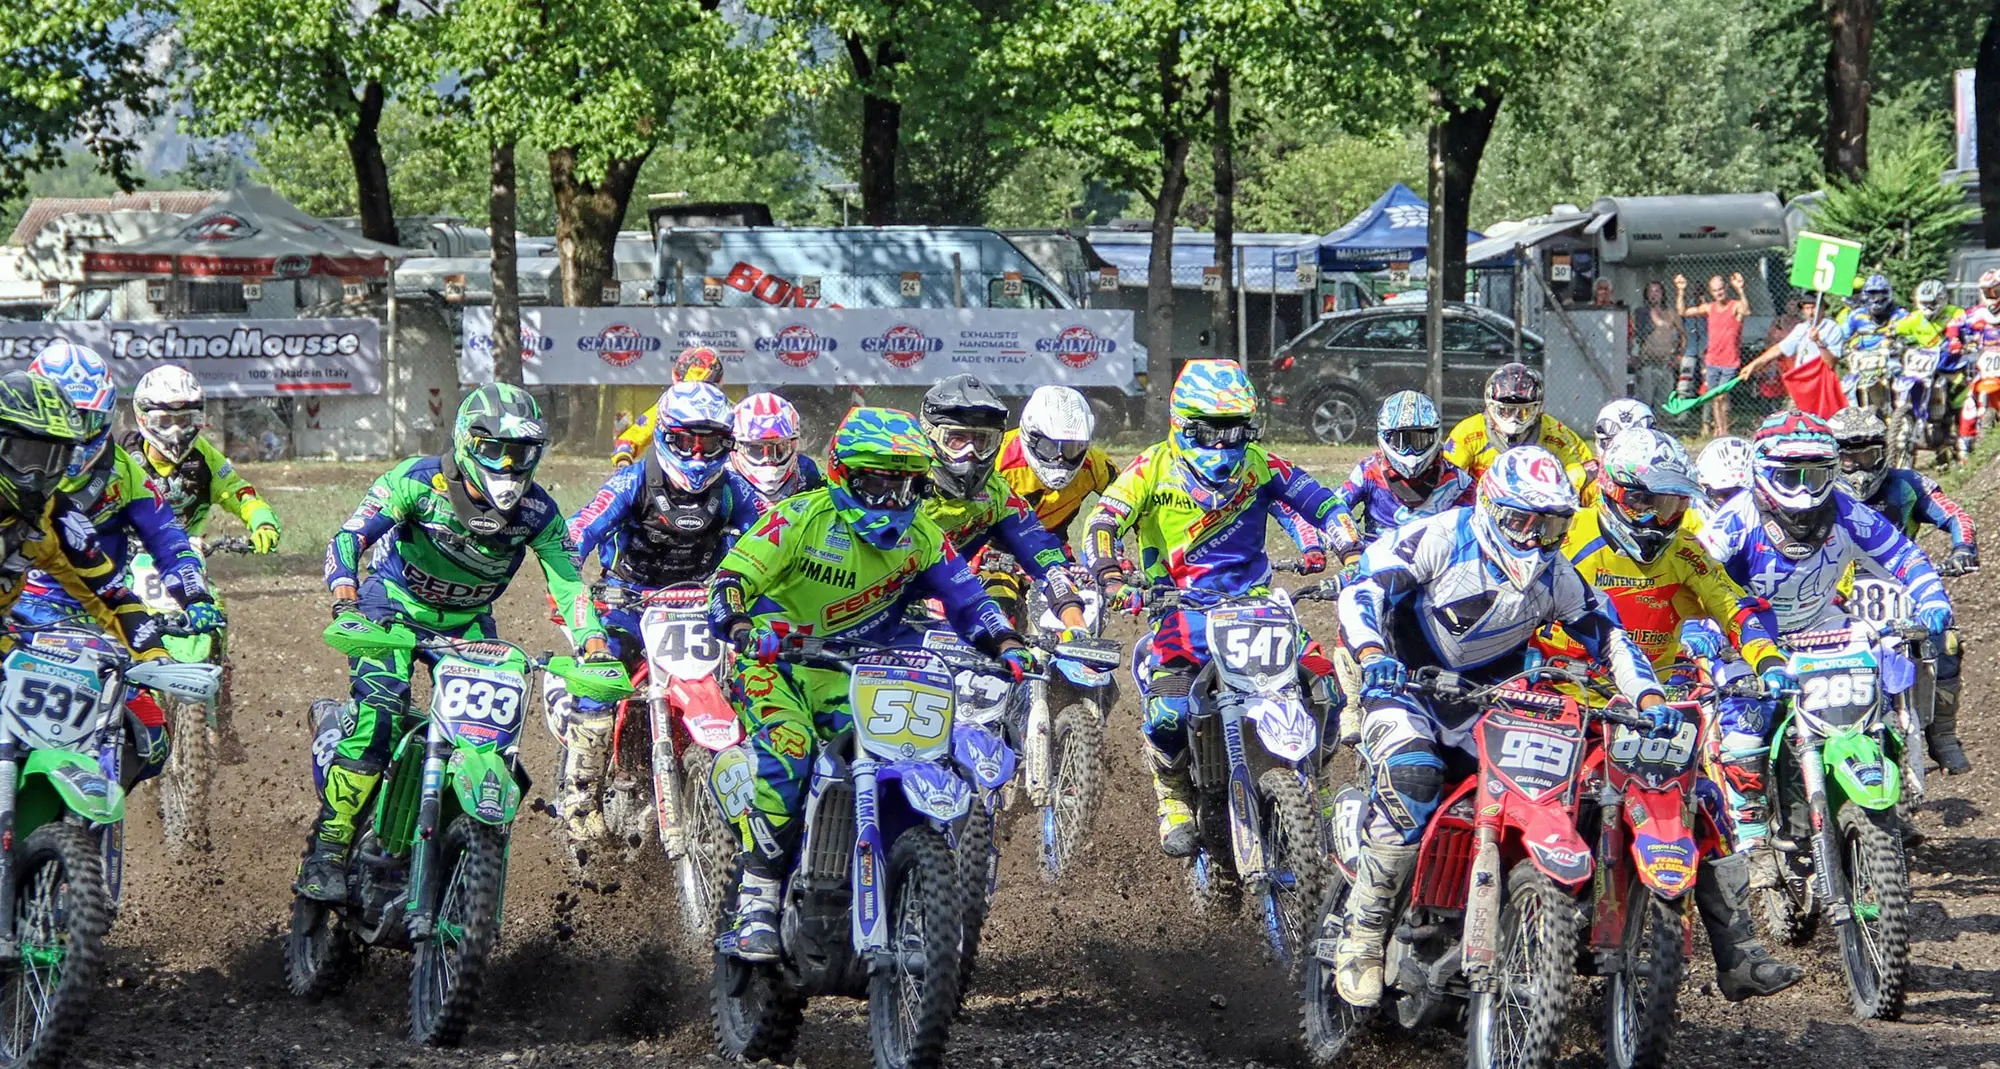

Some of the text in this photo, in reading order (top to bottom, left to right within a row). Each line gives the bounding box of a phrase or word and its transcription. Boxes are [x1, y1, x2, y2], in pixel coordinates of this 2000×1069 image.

[1555, 267, 1567, 277] 30
[1812, 242, 1840, 293] 5
[1102, 277, 1114, 288] 26
[1204, 275, 1217, 287] 27
[1300, 273, 1312, 283] 28
[1393, 273, 1405, 281] 29
[245, 286, 258, 297] 18
[803, 285, 817, 297] 23
[903, 281, 916, 293] 24
[1005, 281, 1018, 292] 25
[602, 289, 617, 301] 21
[705, 287, 719, 299] 22
[678, 330, 738, 339] EXHAUSTS
[960, 331, 1019, 339] EXHAUSTS
[111, 327, 360, 359] TechnoMousse
[581, 336, 655, 351] SCALVINI
[676, 340, 739, 348] HANDMADE
[757, 337, 831, 351] SCALVINI
[865, 338, 938, 351] SCALVINI
[958, 340, 1019, 348] HANDMADE
[1039, 338, 1111, 352] SCALVINI
[951, 356, 1027, 365] MADE IN ITALY
[280, 370, 307, 378] Made
[309, 370, 322, 378] in
[324, 369, 348, 380] Italy
[1208, 519, 1245, 549] Road
[655, 623, 721, 662] 43
[1226, 626, 1292, 669] 547
[441, 664, 481, 673] PEDRI
[1813, 657, 1865, 668] MOTOREX
[1804, 673, 1875, 711] 285
[16, 677, 96, 728] 537
[440, 679, 519, 725] 833
[867, 688, 950, 738] 55
[1497, 730, 1574, 777] 923
[1546, 851, 1581, 865] NILS
[1654, 857, 1683, 865] TEAM
